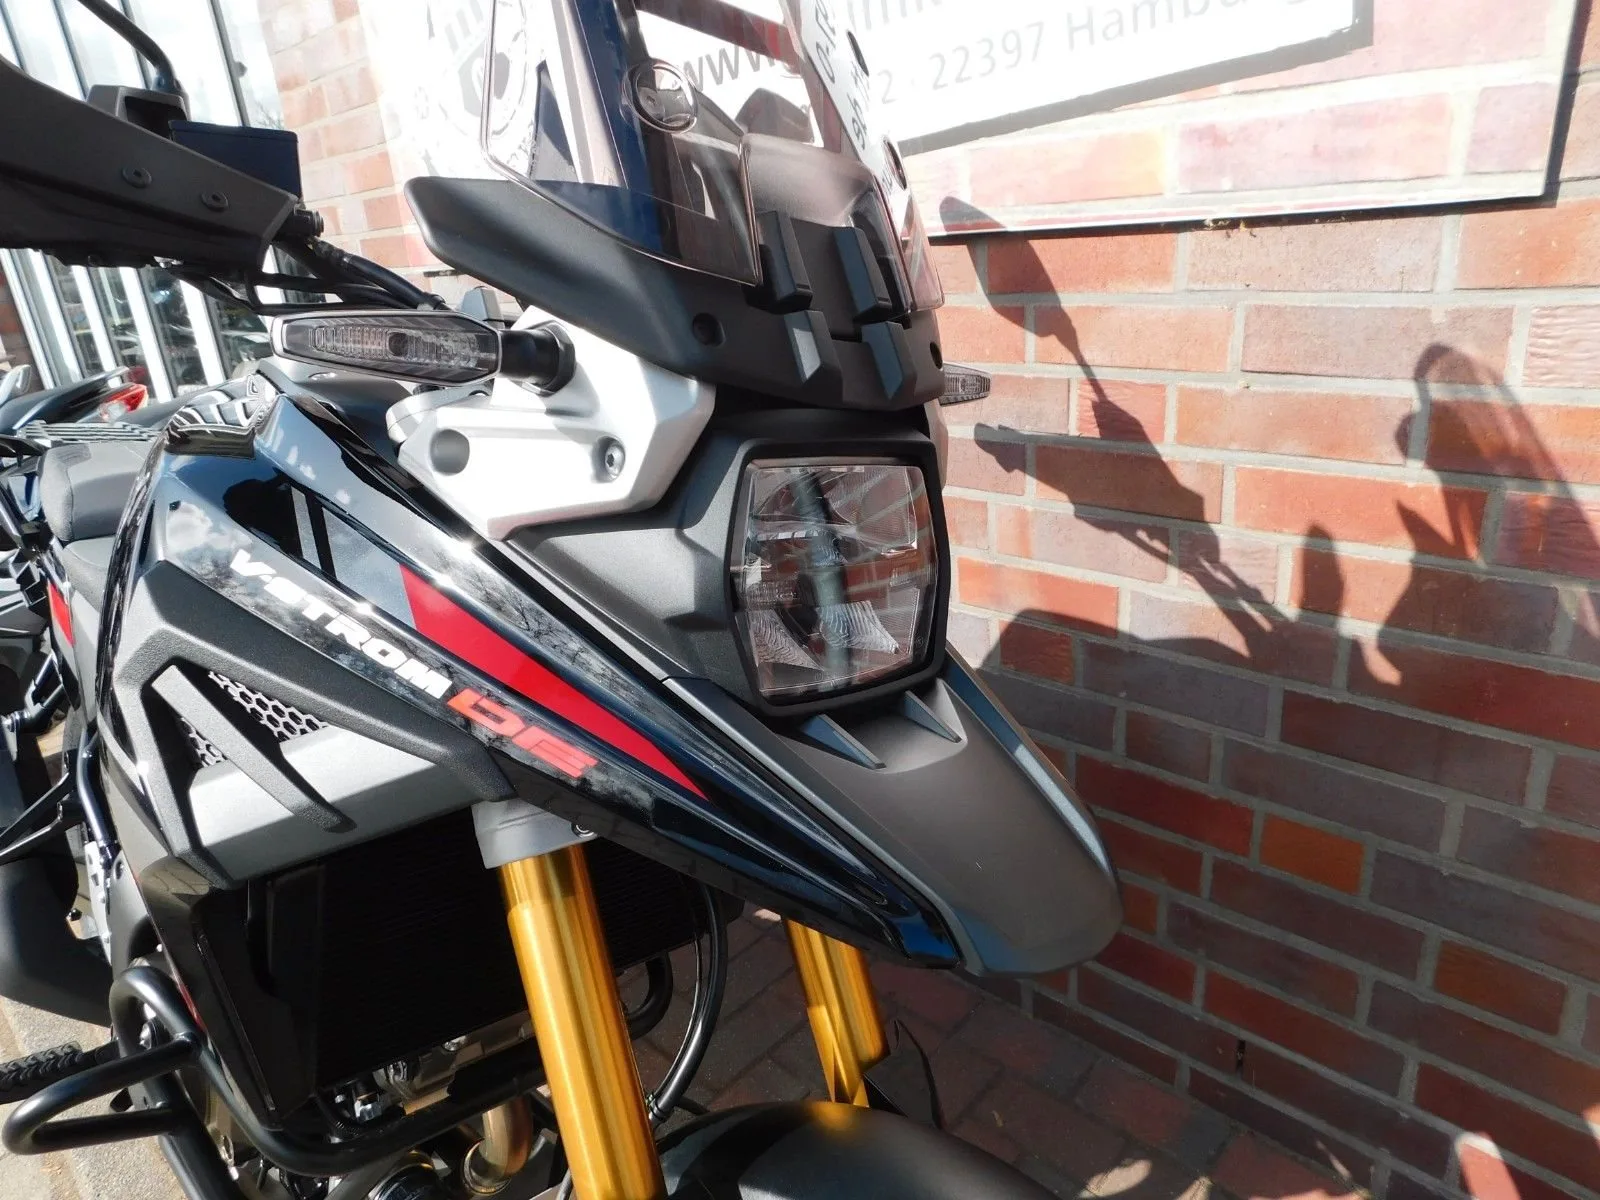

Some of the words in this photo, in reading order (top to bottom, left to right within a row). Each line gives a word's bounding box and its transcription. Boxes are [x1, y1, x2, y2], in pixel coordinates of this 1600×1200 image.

[928, 20, 1045, 91] 22397
[230, 548, 453, 699] V-STROM
[447, 688, 599, 779] DE
